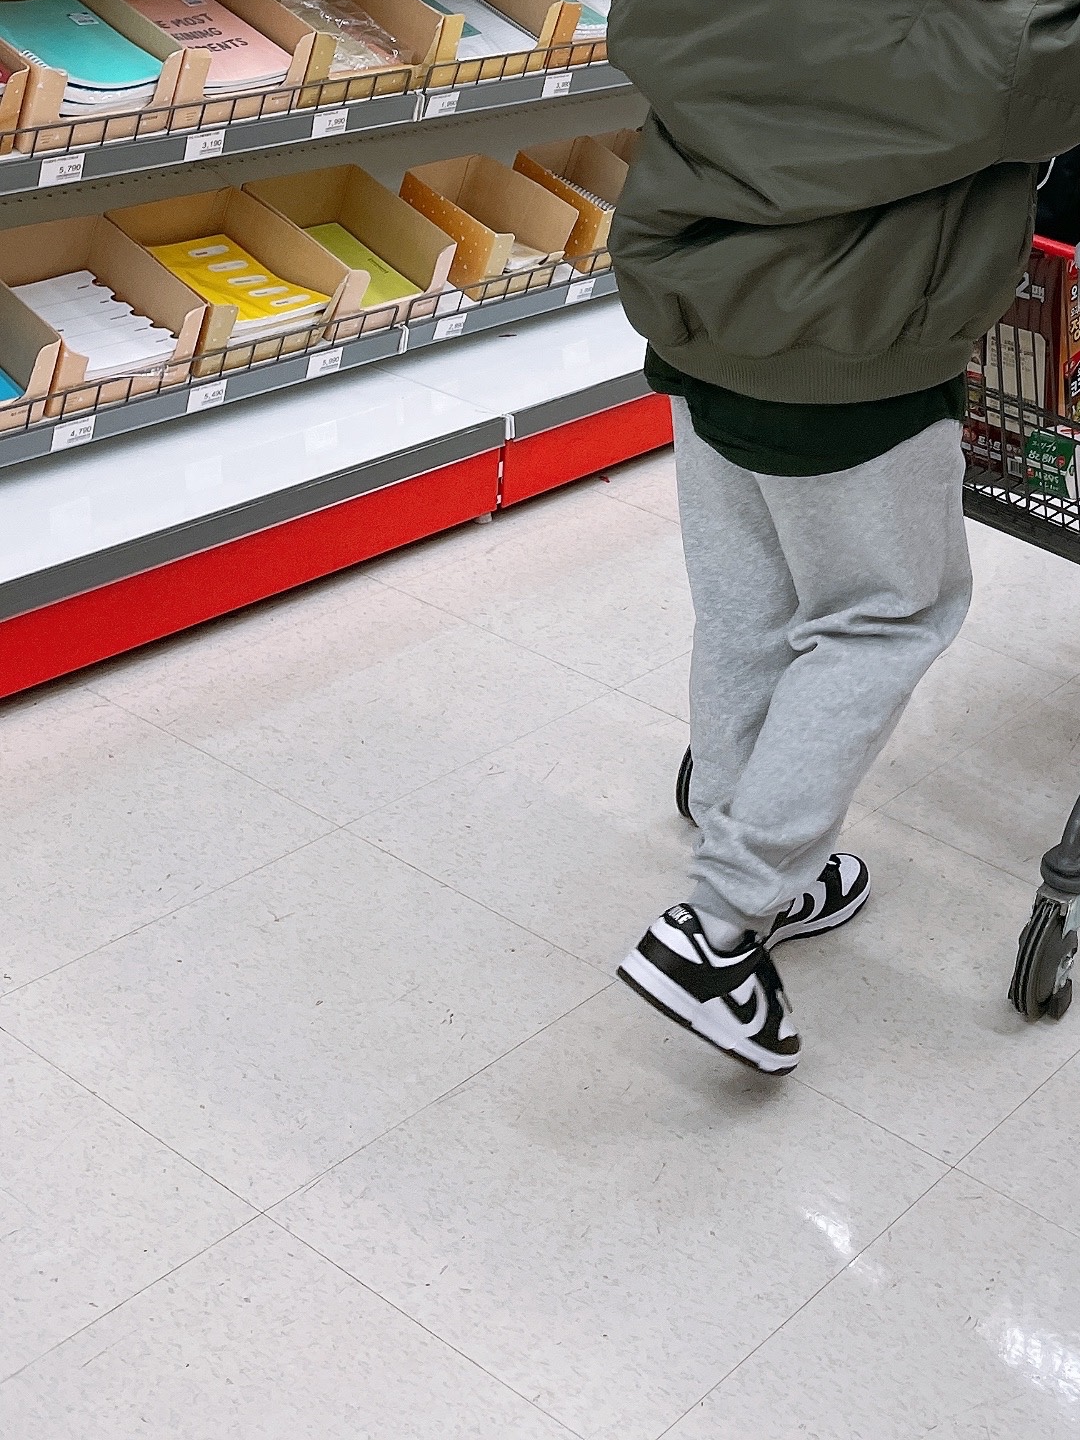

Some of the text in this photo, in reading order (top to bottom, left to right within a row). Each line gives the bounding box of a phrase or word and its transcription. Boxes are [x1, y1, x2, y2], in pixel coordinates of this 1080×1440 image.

[171, 12, 214, 27] MOST
[327, 116, 346, 127] 7,990
[201, 139, 223, 150] 3,190
[59, 163, 82, 175] 5,790
[69, 425, 92, 438] 4,790
